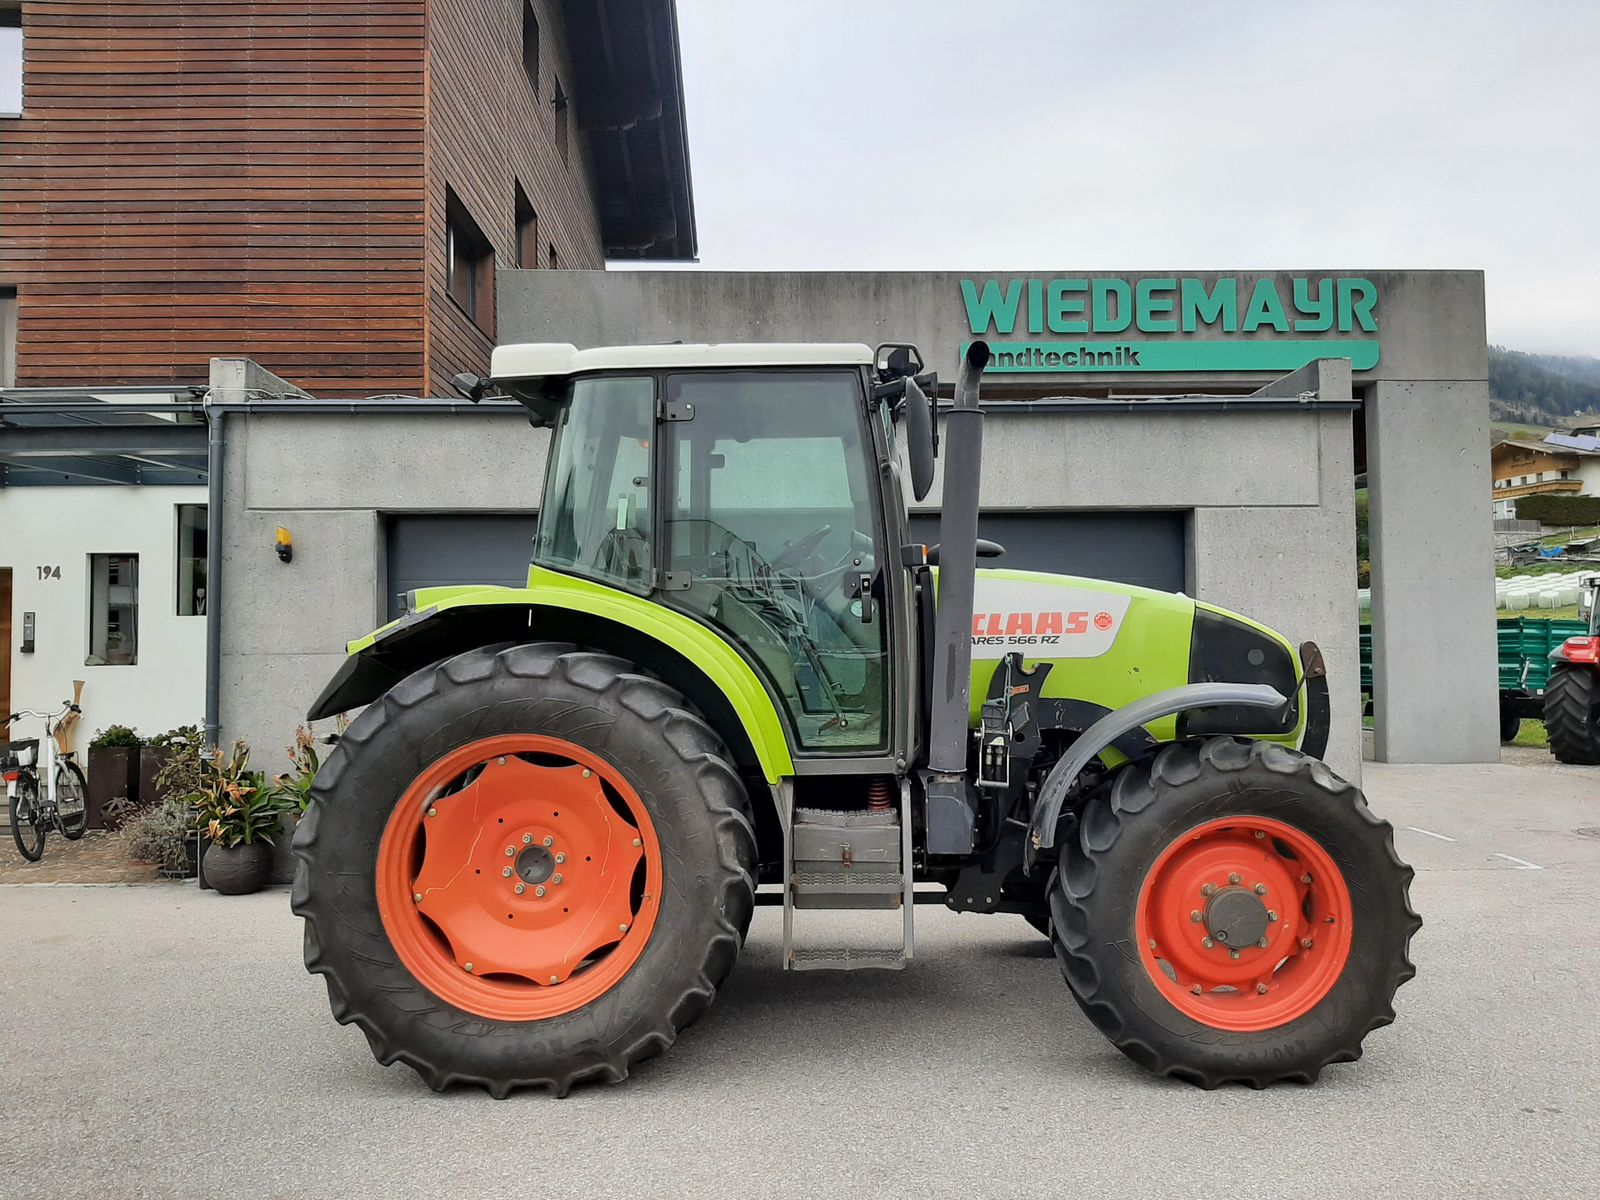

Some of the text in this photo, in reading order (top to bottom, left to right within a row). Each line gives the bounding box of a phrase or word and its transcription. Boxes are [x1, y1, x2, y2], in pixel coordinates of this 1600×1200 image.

[960, 278, 1378, 333] WIEDEMAYR
[985, 346, 1140, 367] andtechnik
[36, 565, 61, 580] 194
[972, 612, 1089, 636] CLAAS
[1007, 635, 1037, 645] 566
[1040, 635, 1060, 644] RZ
